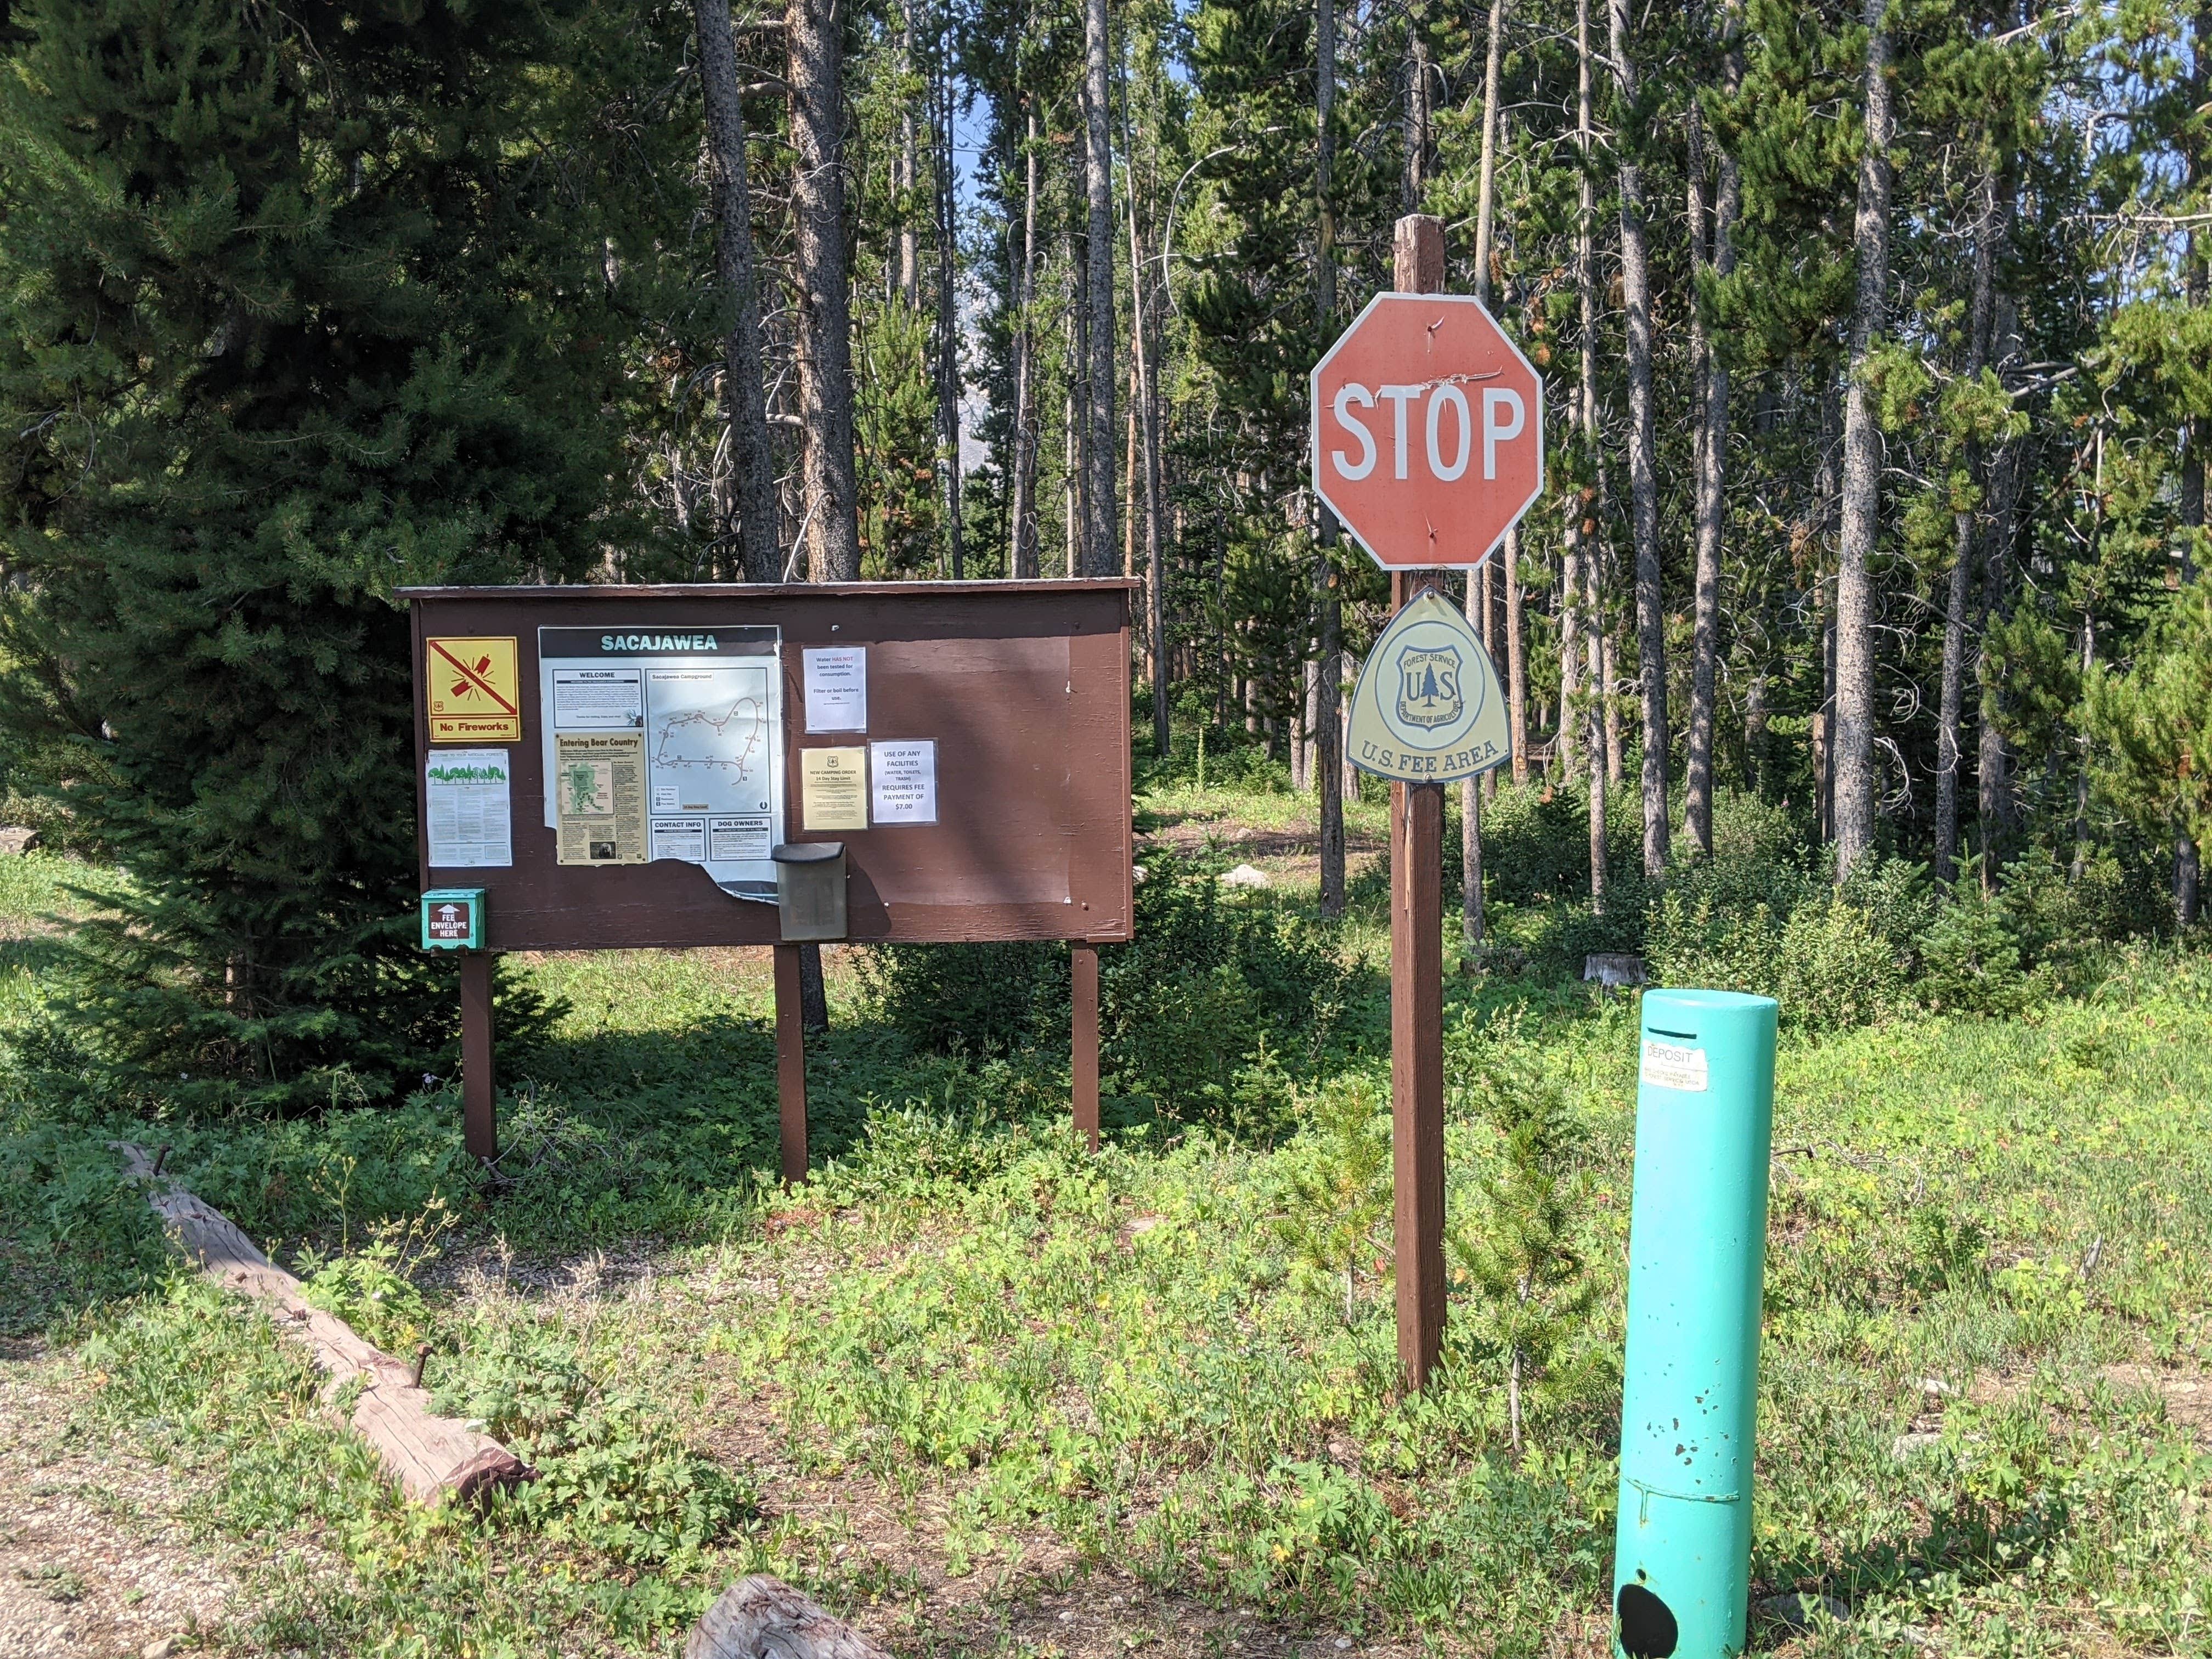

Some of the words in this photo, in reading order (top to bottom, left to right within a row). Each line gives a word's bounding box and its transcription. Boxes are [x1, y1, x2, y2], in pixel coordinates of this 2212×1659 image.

[1332, 382, 1525, 481] STOP
[601, 635, 718, 651] SACAJAWEA
[1404, 654, 1427, 669] FOREST
[1429, 653, 1455, 669] SERVICE
[1400, 701, 1426, 723] DEPARTMENT
[1433, 699, 1460, 723] AGRICULTURE
[440, 723, 453, 731] No
[459, 723, 509, 731] Fireworks
[560, 738, 589, 748] Entering
[610, 738, 638, 748] Country
[1362, 740, 1393, 768] U.S.
[1398, 754, 1436, 772] FEE
[1443, 740, 1498, 771] AREA
[1647, 1046, 1694, 1063] DEPOSIT
